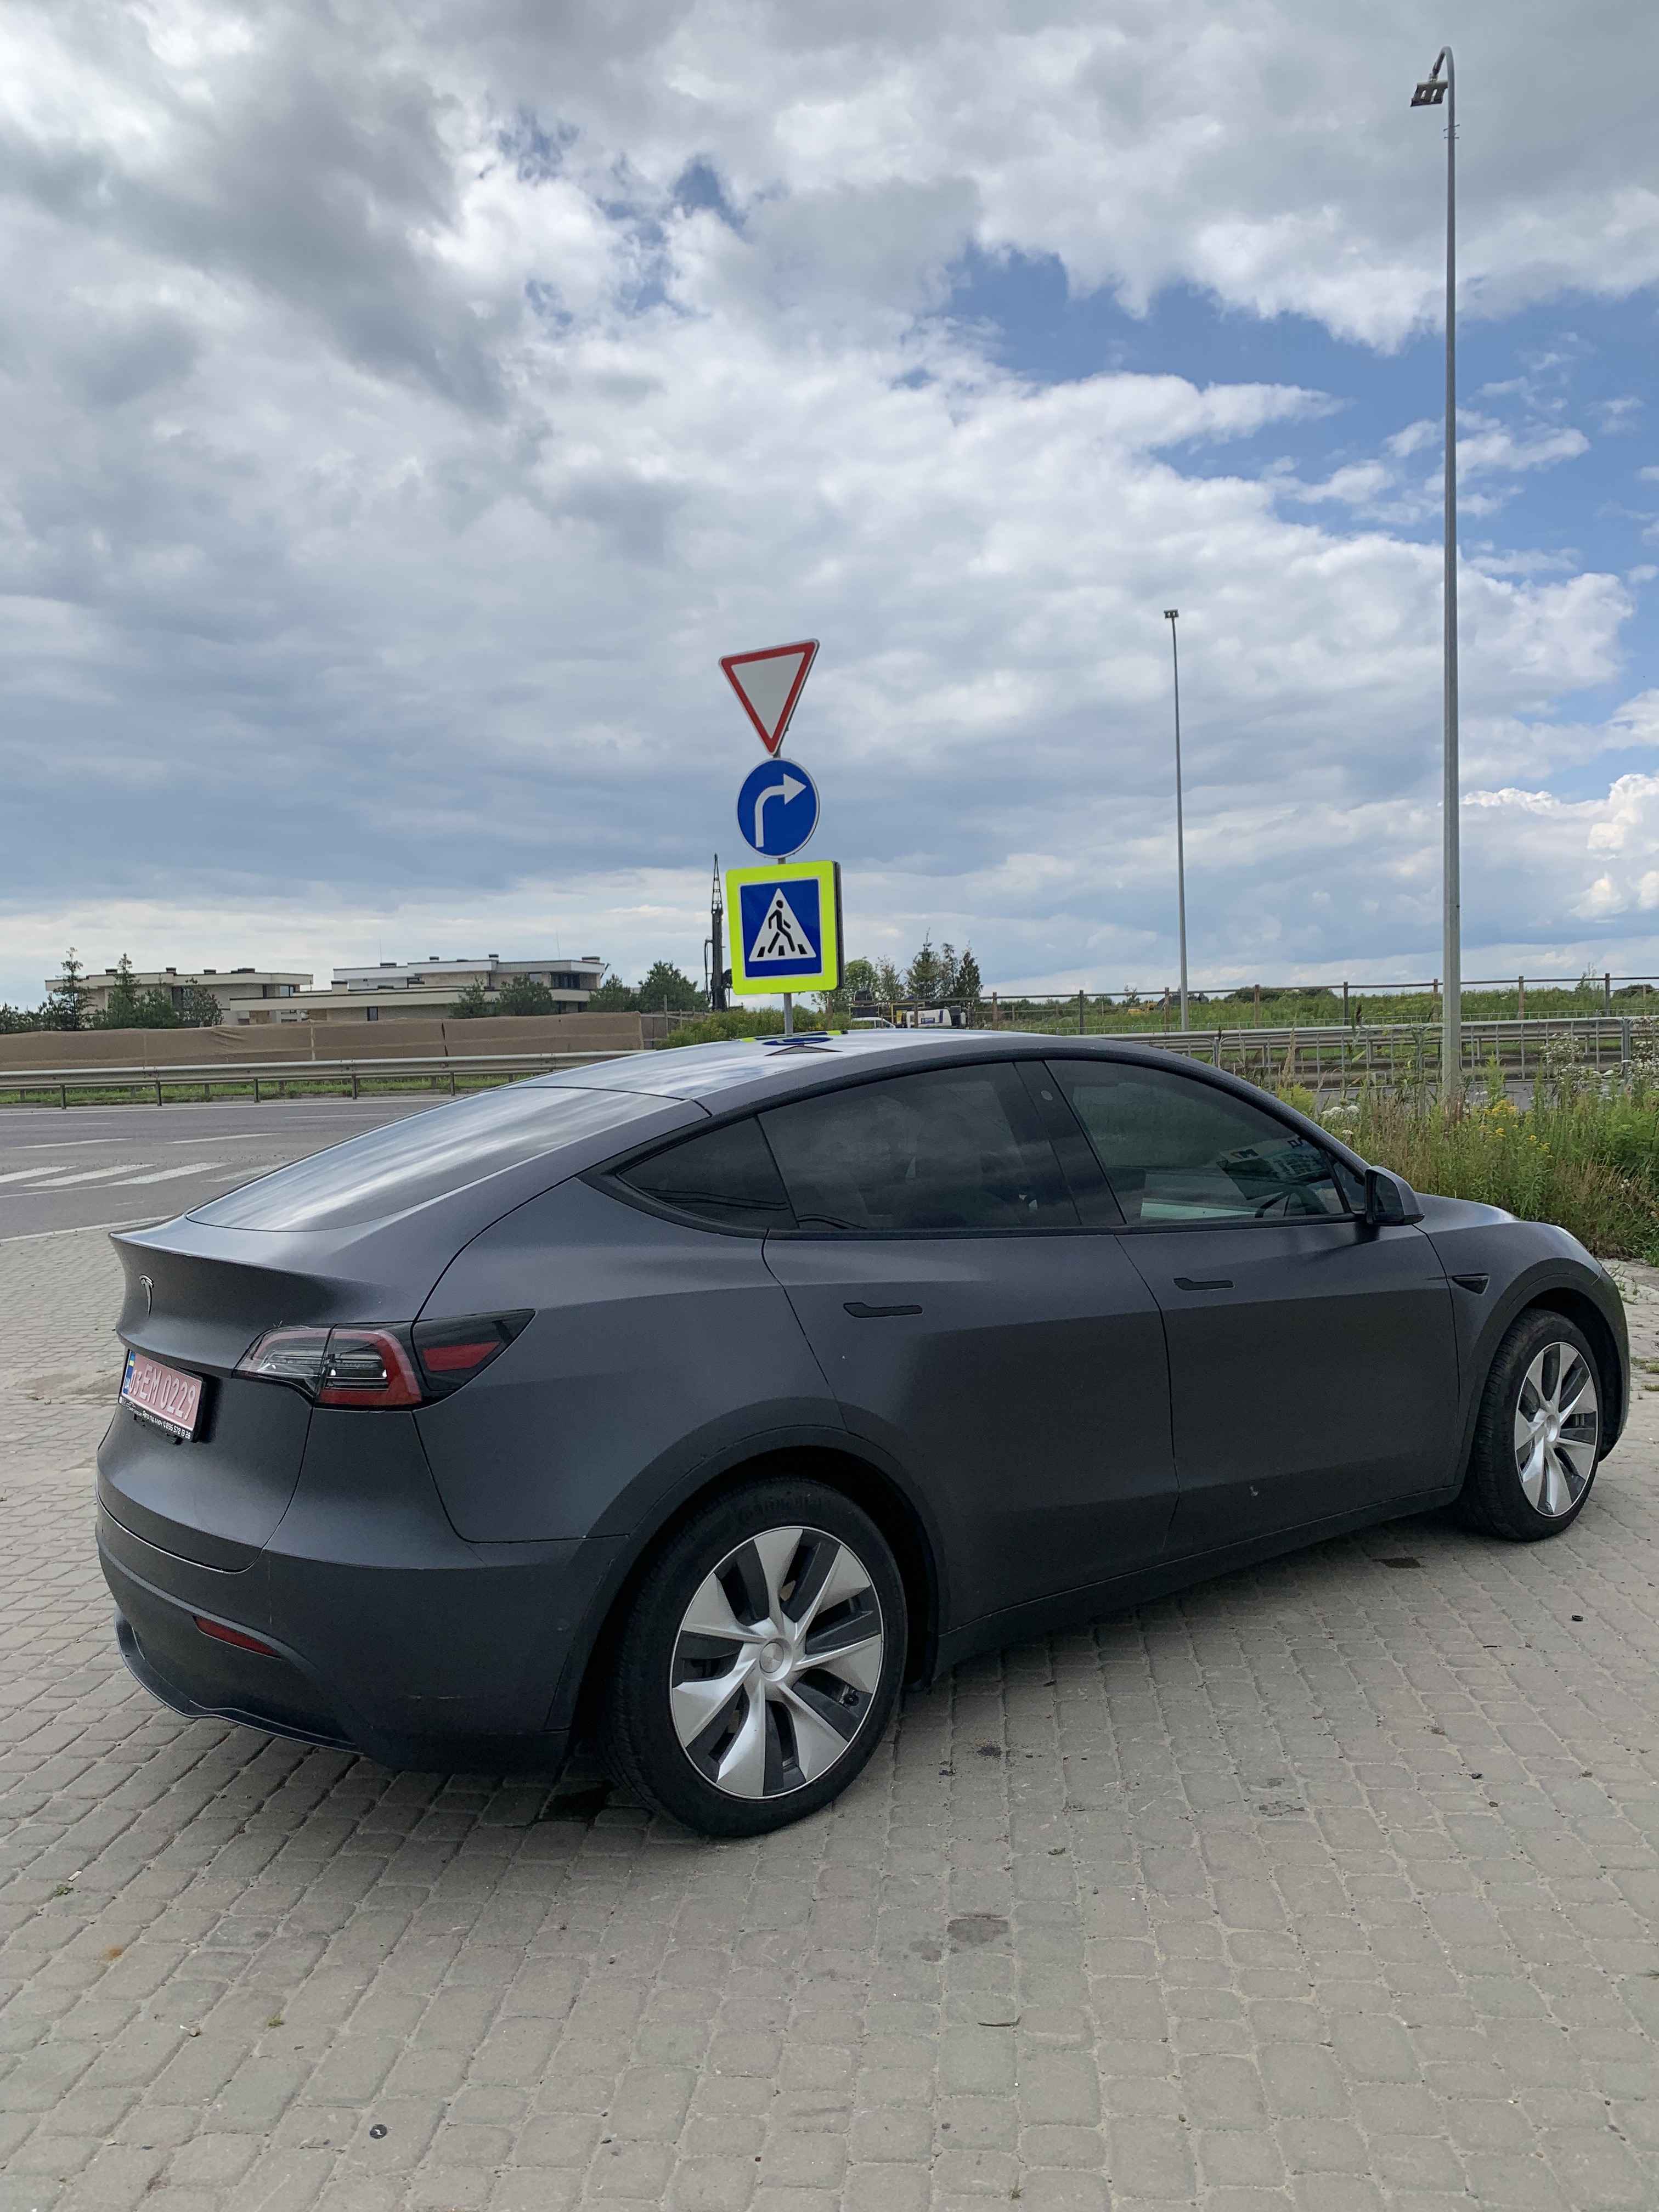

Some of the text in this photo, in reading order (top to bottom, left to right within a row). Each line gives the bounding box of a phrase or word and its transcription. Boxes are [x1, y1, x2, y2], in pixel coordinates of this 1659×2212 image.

[129, 1363, 196, 1421] 03 EM 0229
